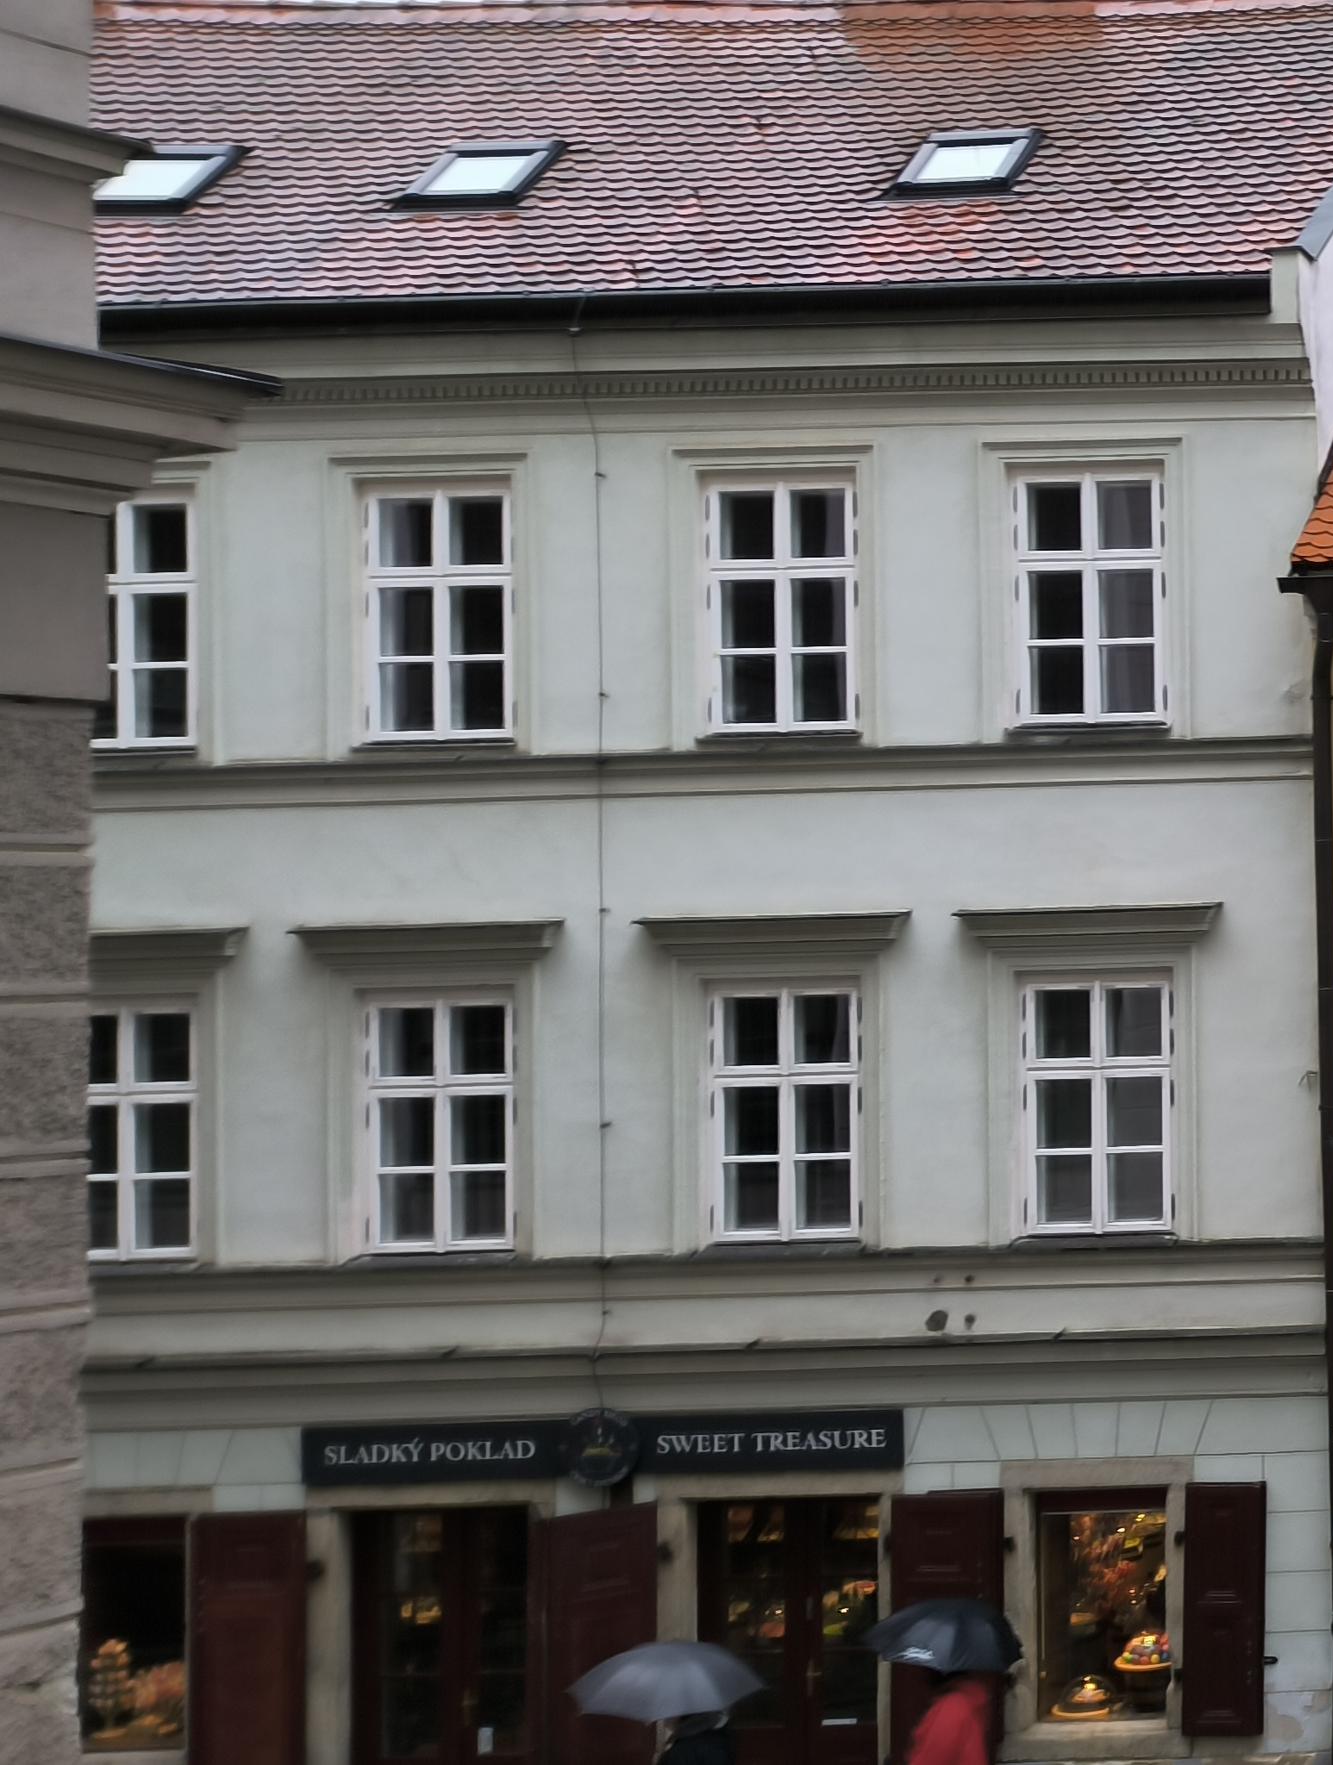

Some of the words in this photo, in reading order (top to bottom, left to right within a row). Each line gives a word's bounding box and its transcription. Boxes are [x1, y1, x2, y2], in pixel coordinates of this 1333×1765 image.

[323, 1437, 424, 1465] SLADKÝ
[429, 1440, 536, 1461] POKLAD
[655, 1432, 746, 1454] SWEET
[751, 1428, 887, 1453] TREASURE
